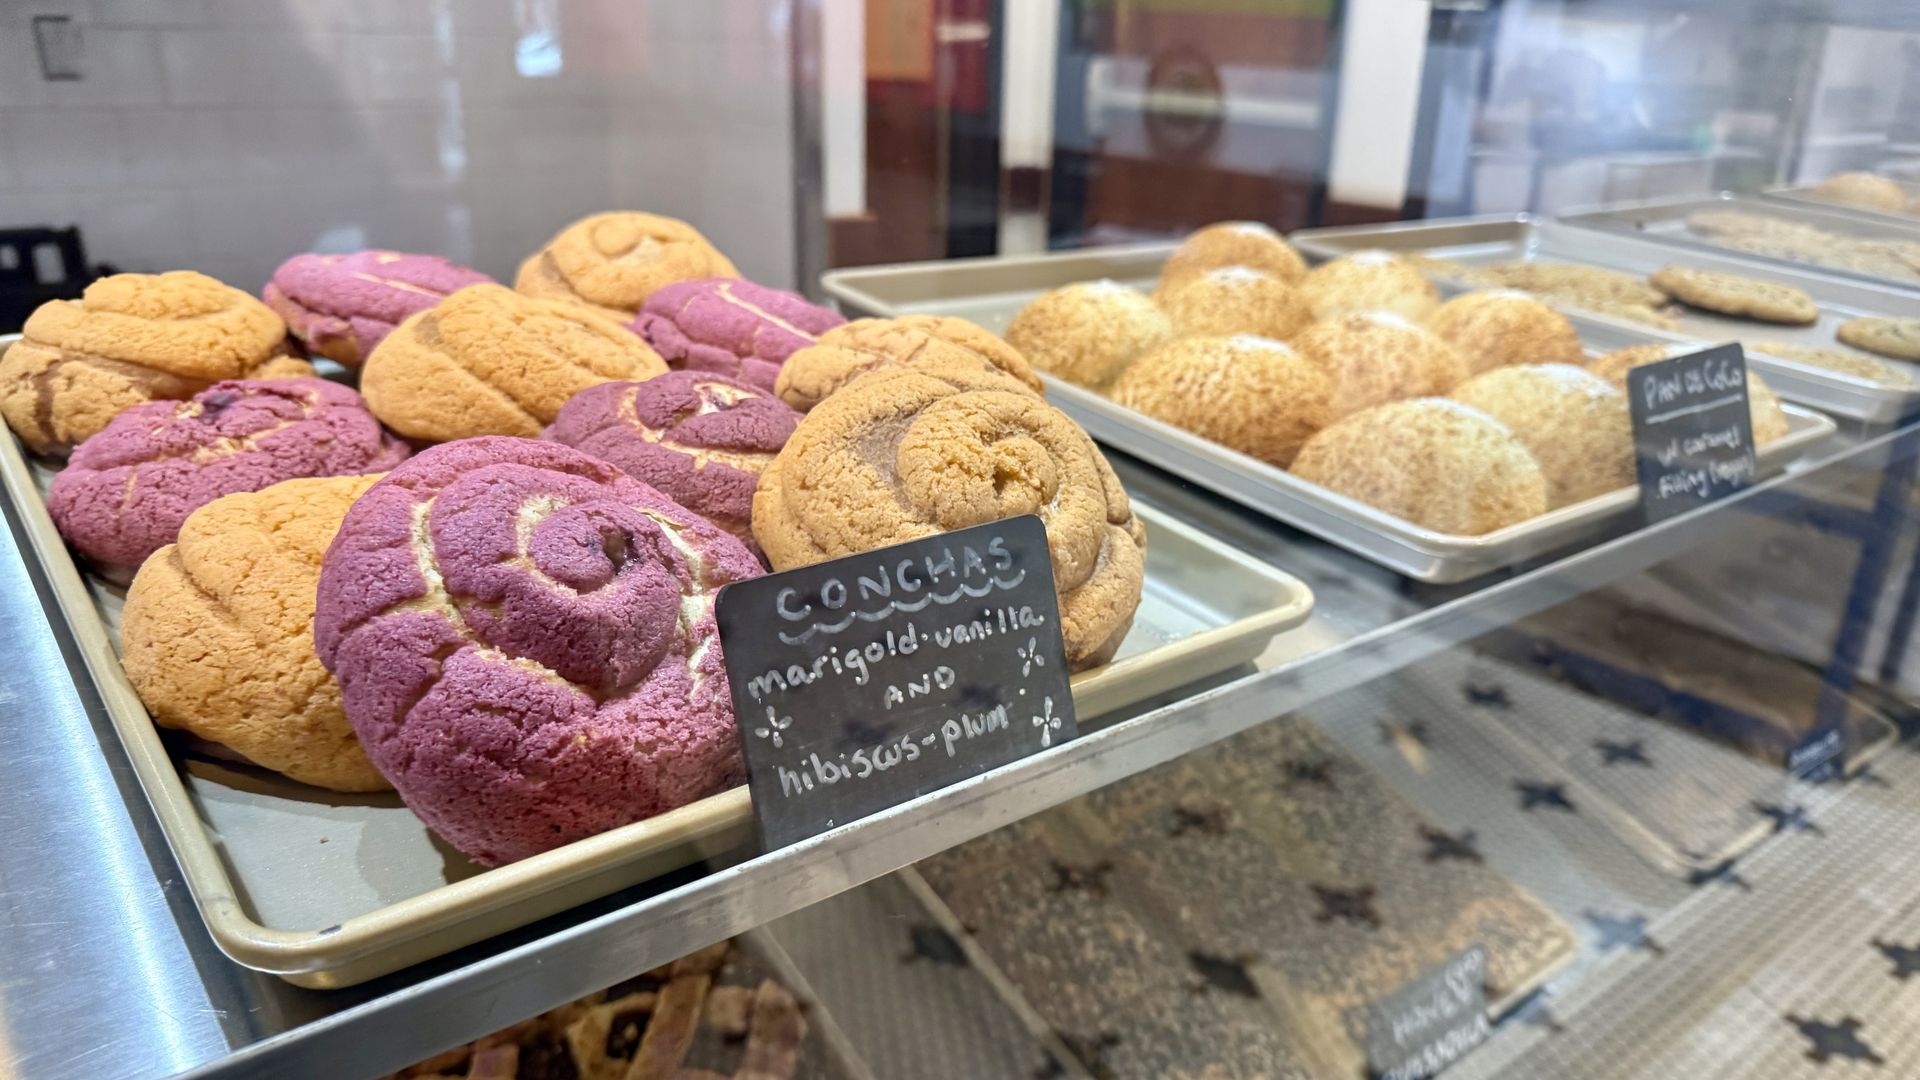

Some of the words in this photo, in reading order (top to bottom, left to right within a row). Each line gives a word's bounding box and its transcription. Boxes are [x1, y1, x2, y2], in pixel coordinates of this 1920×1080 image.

[775, 536, 1013, 621] CONCHAS
[883, 665, 956, 710] AND
[778, 704, 1010, 798] hibiscus-plum
